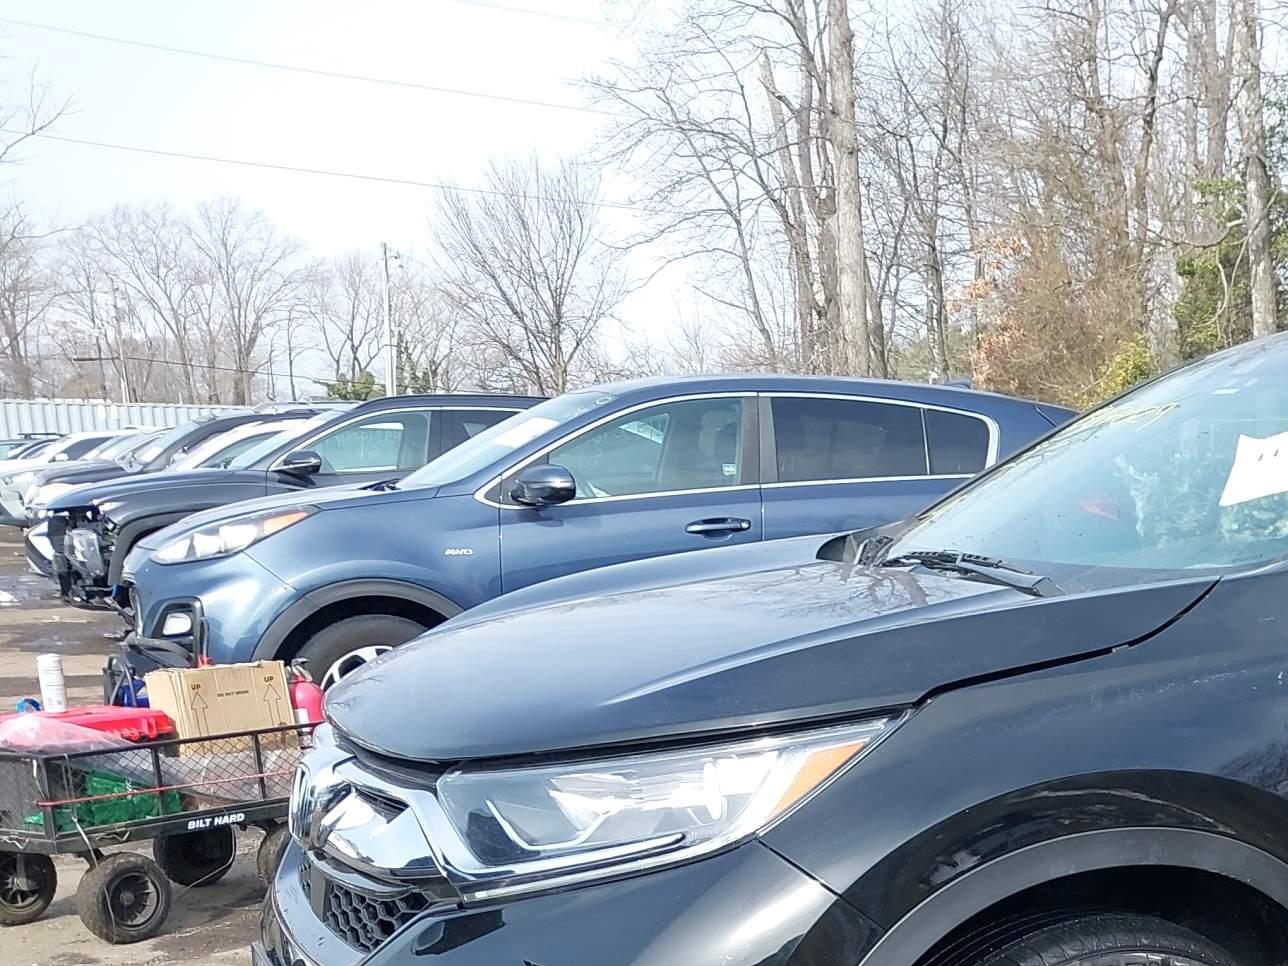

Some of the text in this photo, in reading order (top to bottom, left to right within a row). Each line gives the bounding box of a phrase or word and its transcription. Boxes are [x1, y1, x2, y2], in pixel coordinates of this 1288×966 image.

[445, 548, 474, 556] AWD
[187, 813, 245, 830] BILT HARD
